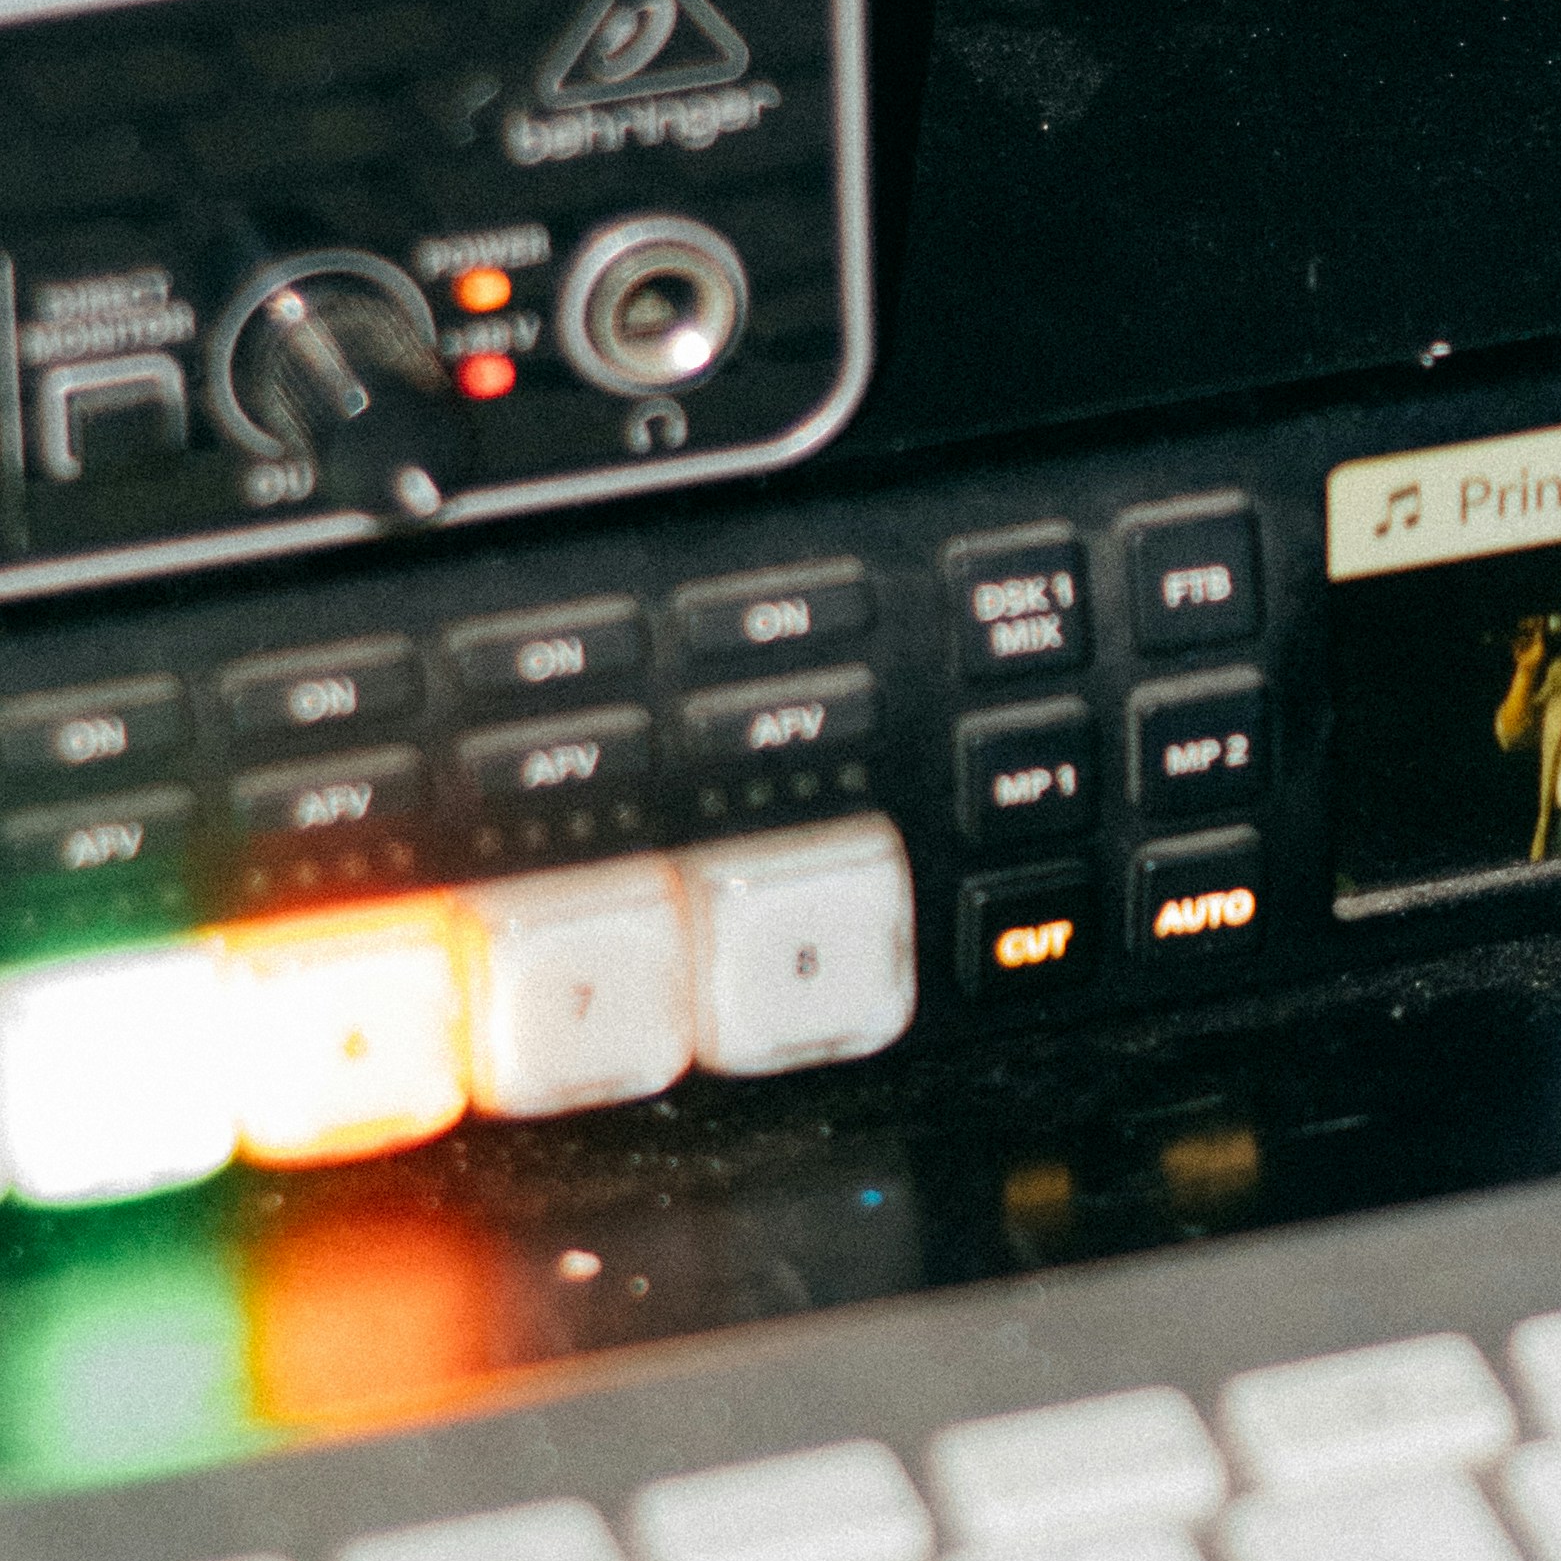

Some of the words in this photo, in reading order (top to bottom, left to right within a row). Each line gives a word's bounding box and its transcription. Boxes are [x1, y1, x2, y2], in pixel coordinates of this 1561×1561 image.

[973, 576, 1051, 621] DSK
[1052, 571, 1075, 610] 1
[1163, 564, 1232, 608] FTB
[743, 599, 811, 643] ON
[990, 613, 1064, 658] MIX
[515, 637, 586, 682] ON
[288, 678, 358, 726] ON
[54, 716, 127, 766] ON
[1165, 738, 1221, 776] MP
[1225, 733, 1249, 769] 2
[994, 768, 1052, 807] MP
[1055, 764, 1077, 798] 1
[1154, 887, 1256, 939] AUTO
[994, 919, 1073, 969] CUT
